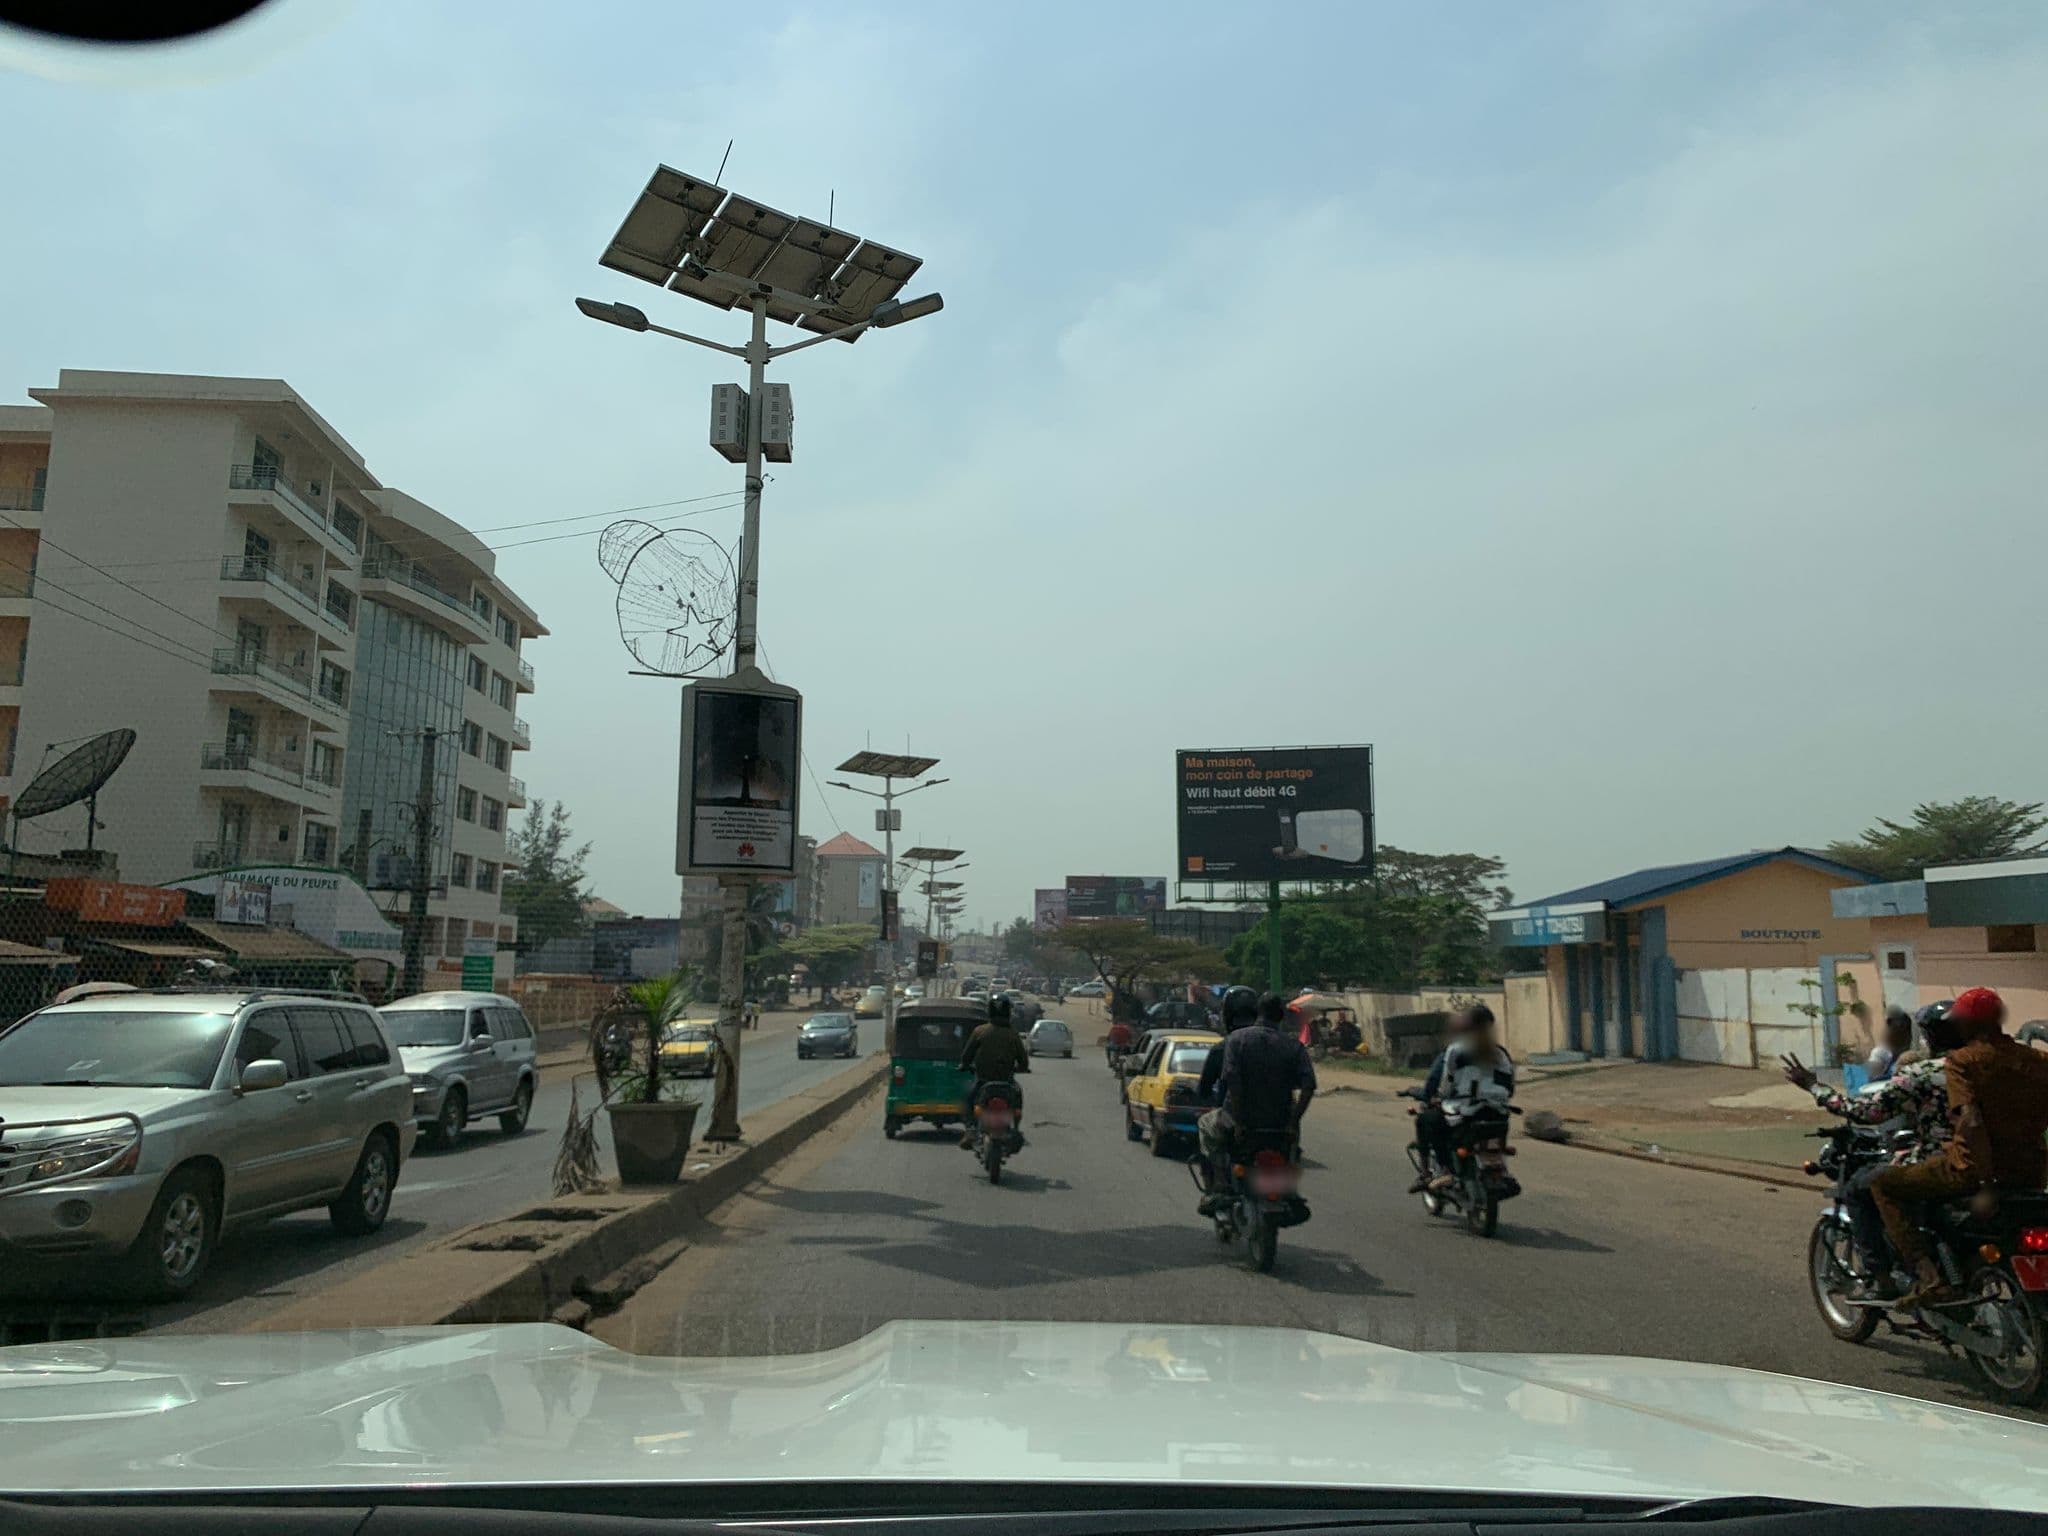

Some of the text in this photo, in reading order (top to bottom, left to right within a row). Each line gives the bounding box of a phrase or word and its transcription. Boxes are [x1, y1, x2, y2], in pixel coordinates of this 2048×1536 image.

[1185, 758, 1203, 768] Ma
[1185, 769, 1313, 780] mon coin de partage
[1186, 785, 1296, 799] Wifi haut débit 4G
[283, 876, 299, 887] DU
[301, 877, 339, 890] PEUPLE
[1741, 929, 1823, 940] BOUTIQUE
